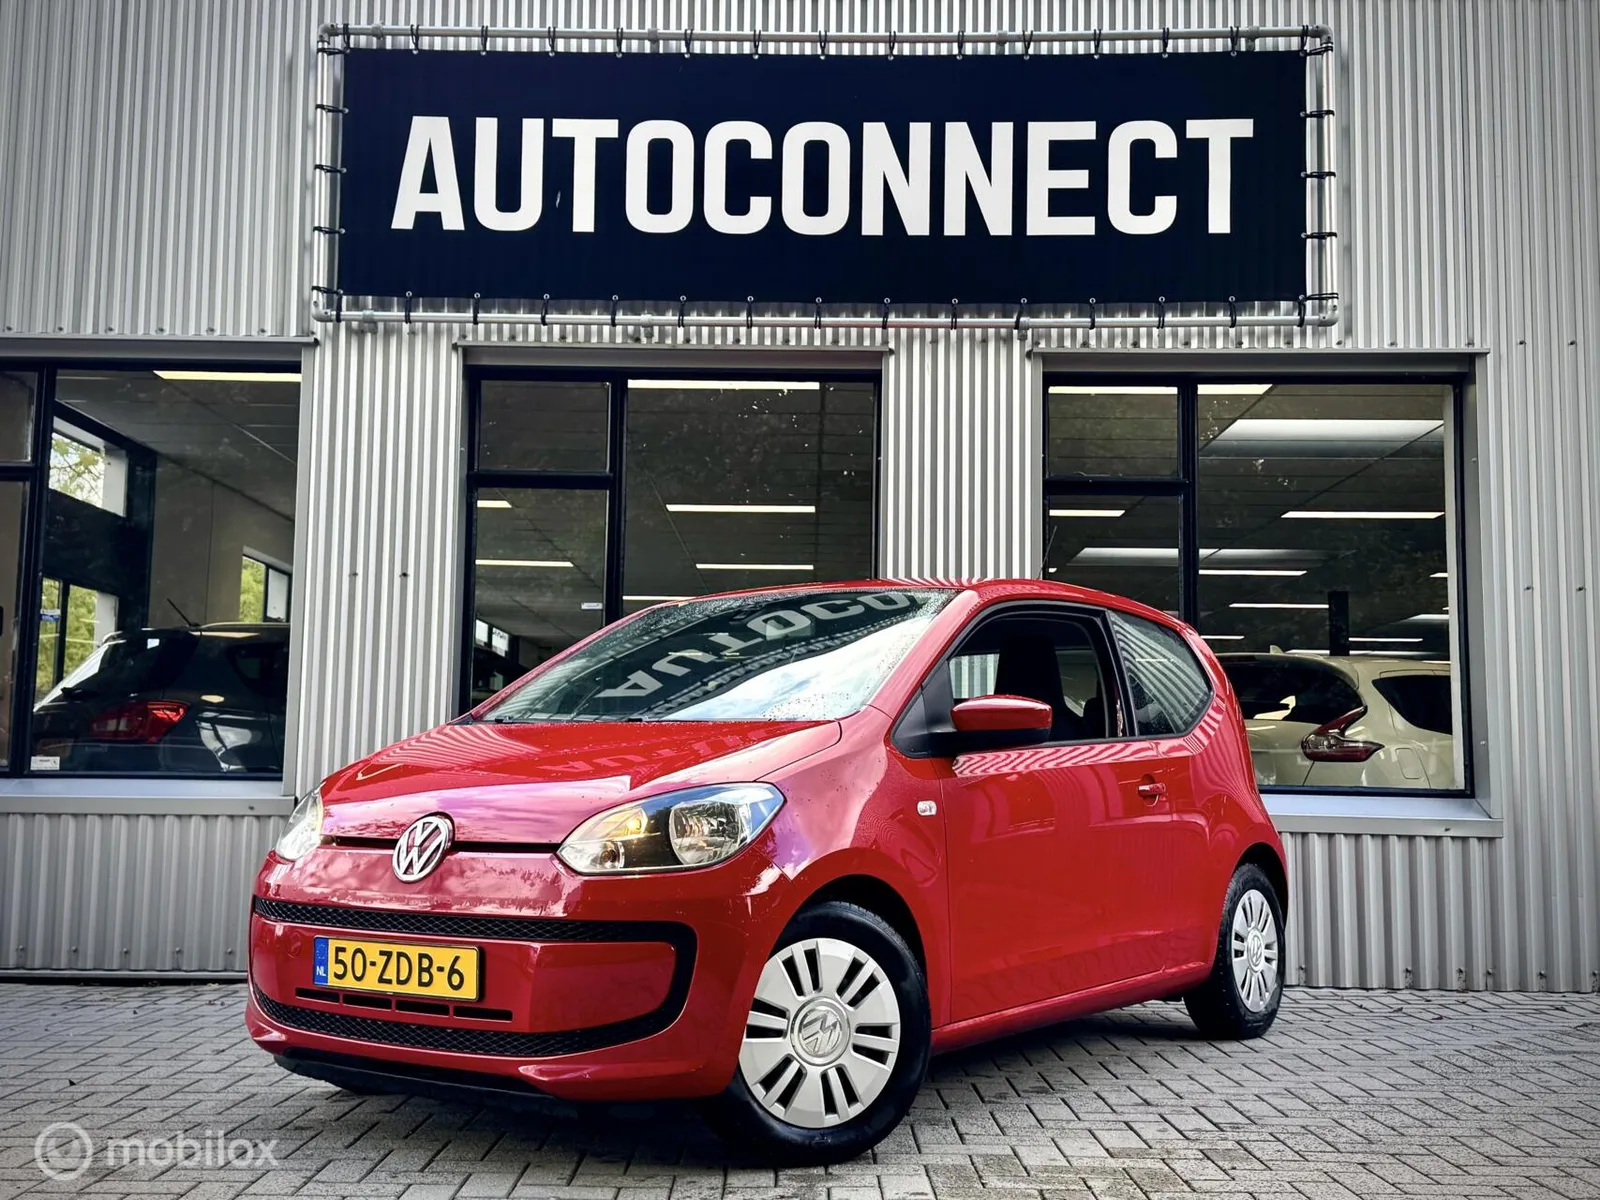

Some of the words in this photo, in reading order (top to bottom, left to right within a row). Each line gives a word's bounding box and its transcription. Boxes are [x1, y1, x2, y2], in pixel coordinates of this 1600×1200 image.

[391, 115, 1254, 236] AUTOCONNECT
[316, 966, 326, 977] NL
[333, 946, 465, 991] 50-ZDB-6
